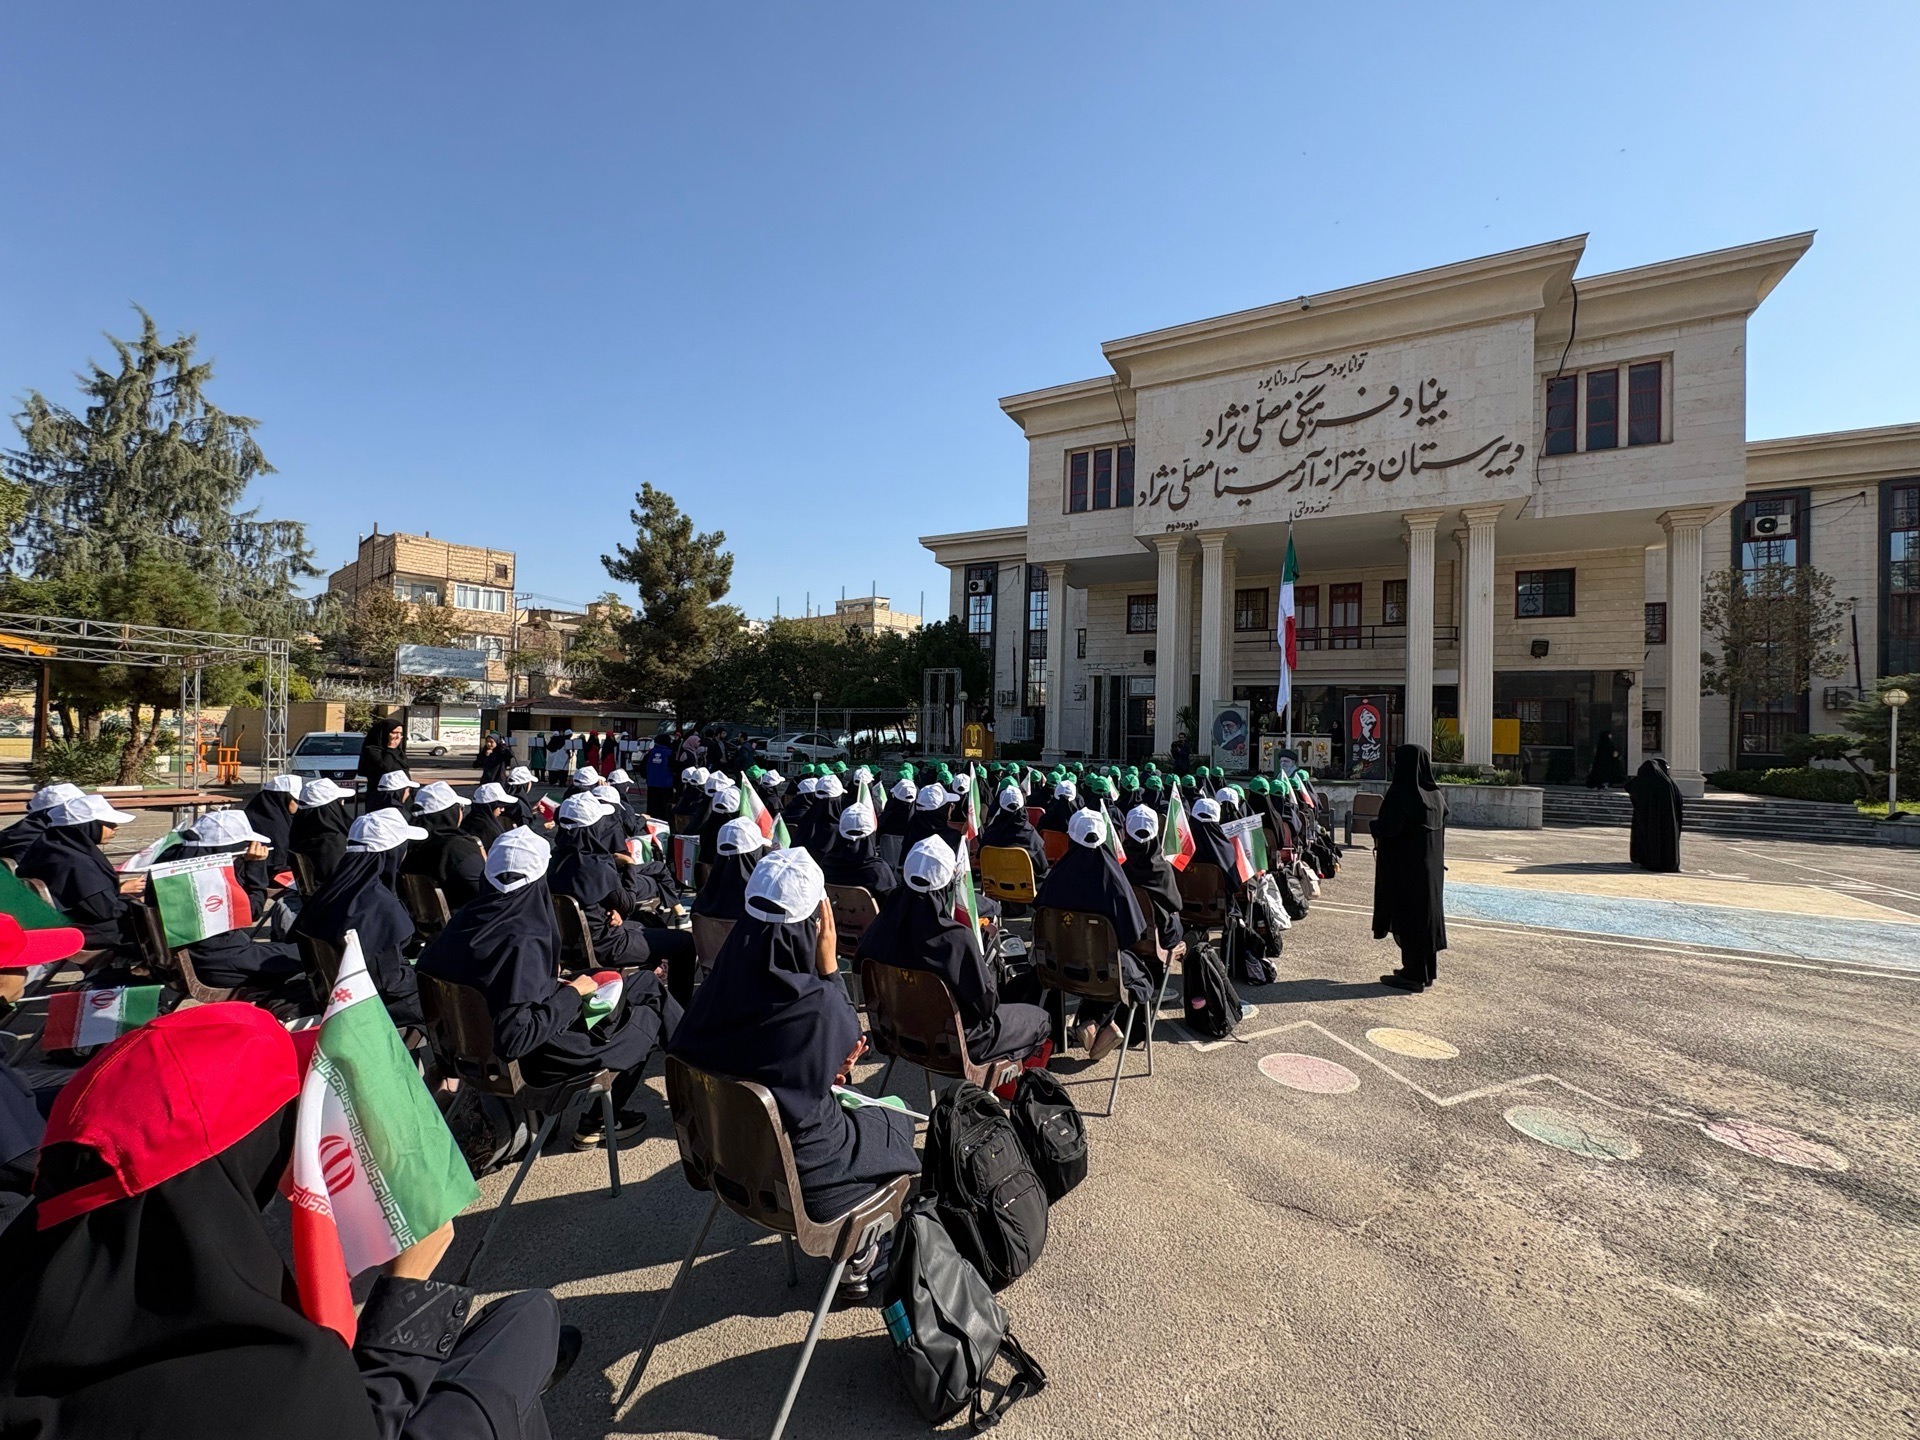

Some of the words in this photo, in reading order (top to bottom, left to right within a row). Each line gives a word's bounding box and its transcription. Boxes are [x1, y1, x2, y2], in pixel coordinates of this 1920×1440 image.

[1331, 363, 1346, 378] بود
[1348, 352, 1368, 373] توانا
[1274, 369, 1287, 387] دانا
[1288, 361, 1310, 384] که
[1297, 363, 1333, 383] هر
[1258, 376, 1273, 391] بود
[1399, 378, 1448, 427] بنیاد
[1278, 383, 1400, 447] فرهنگی
[1378, 435, 1525, 482] دبیرستان
[1315, 448, 1375, 491] دخترانه
[1294, 500, 1314, 518] دولتی
[1313, 496, 1332, 513] نمونه
[1165, 521, 1180, 532] دوم
[1180, 519, 1199, 531] دوره
